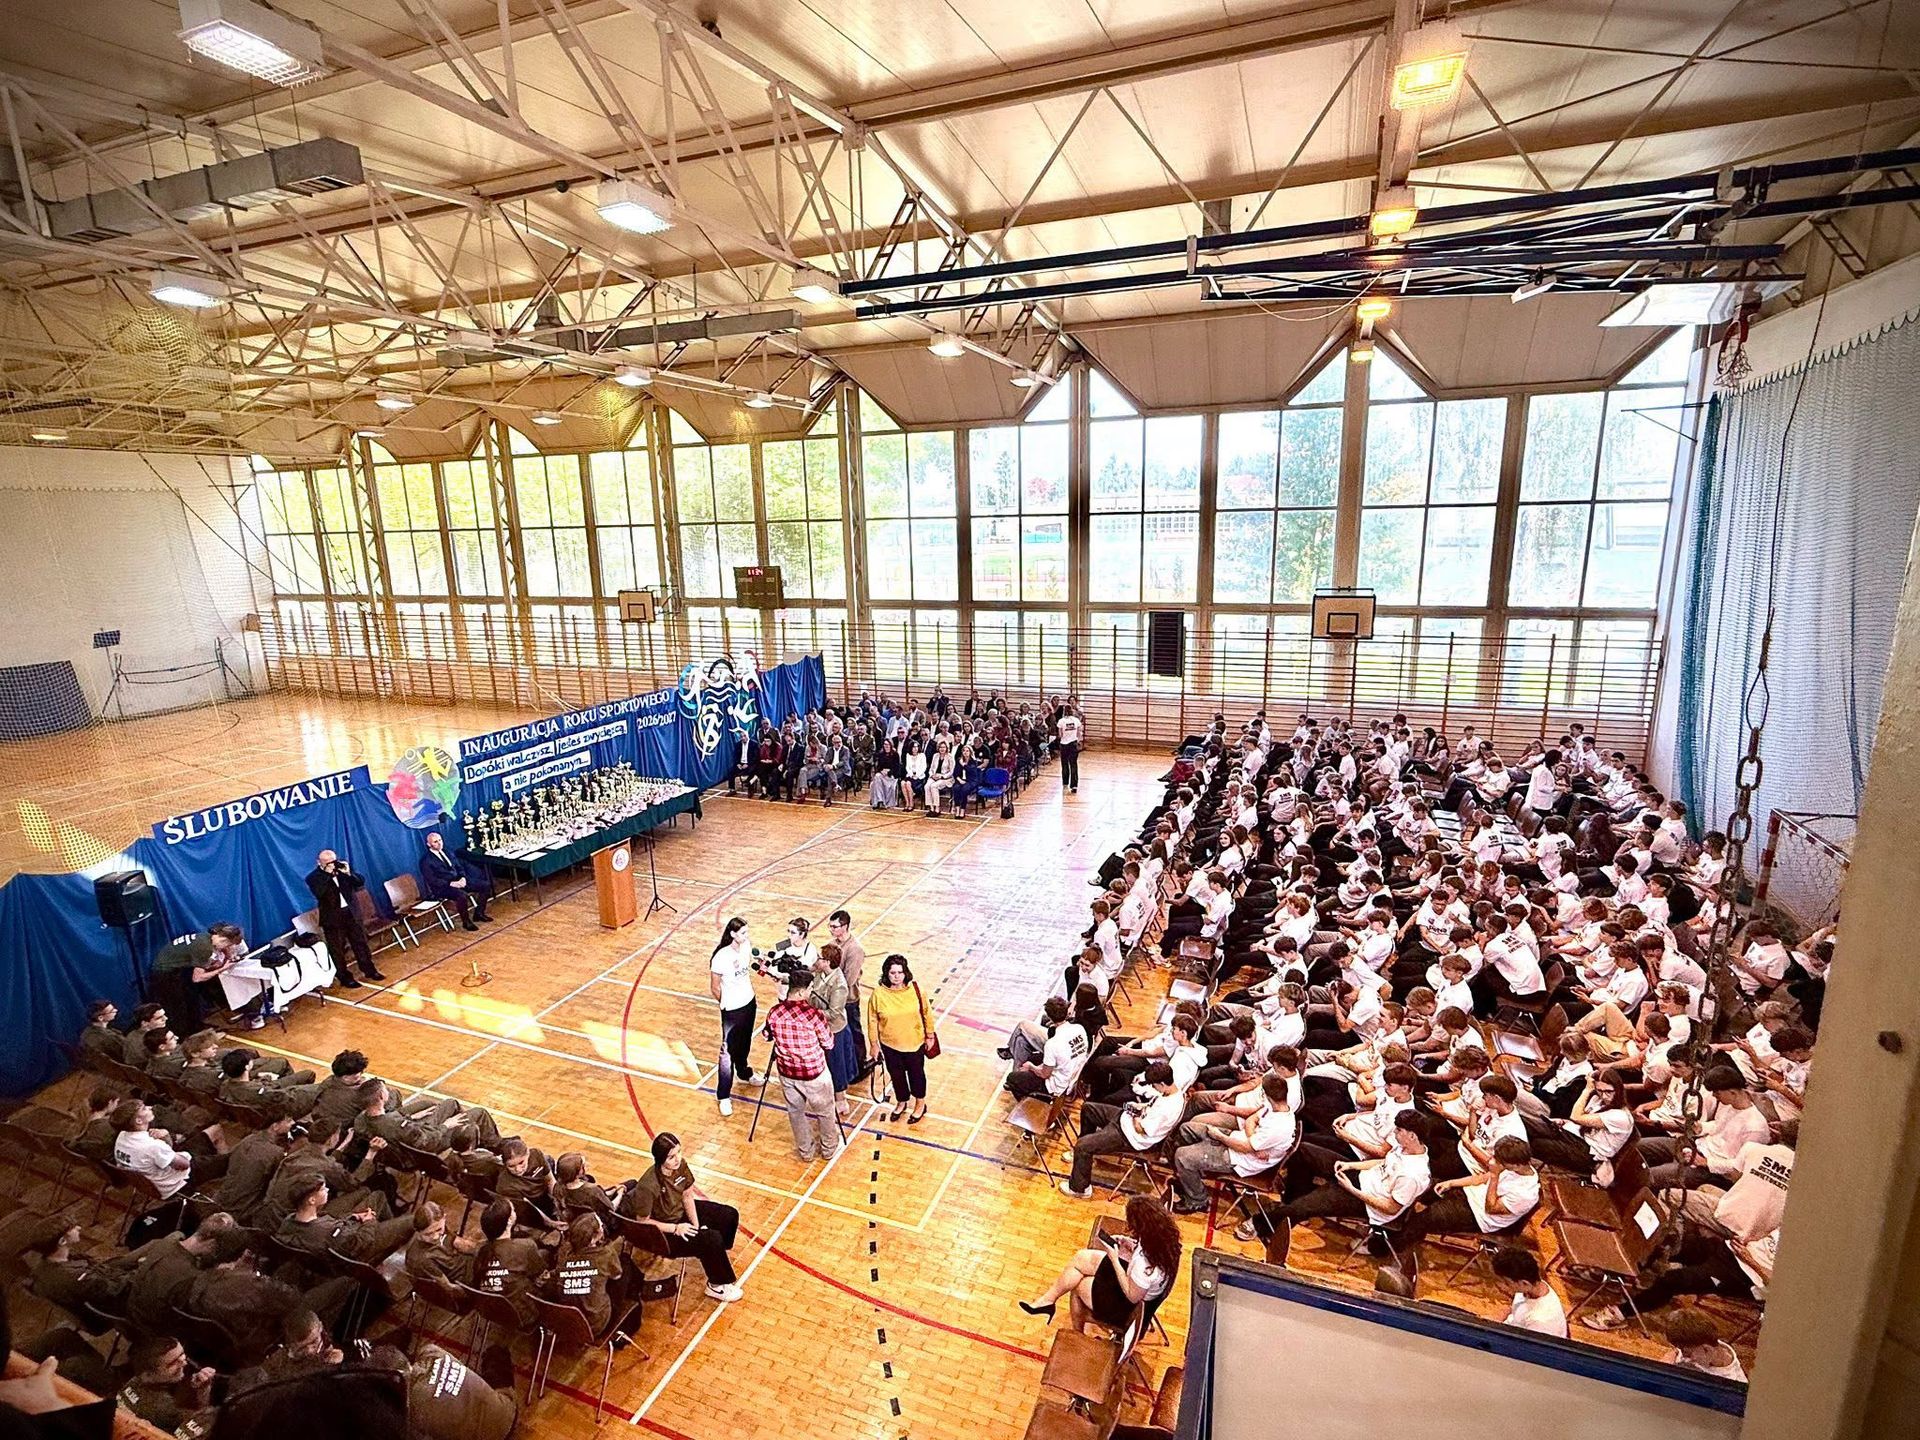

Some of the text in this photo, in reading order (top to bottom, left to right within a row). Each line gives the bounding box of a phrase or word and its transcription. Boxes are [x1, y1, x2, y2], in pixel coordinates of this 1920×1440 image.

[463, 690, 670, 757] INAUGURACJA ROKU SPORTOWEGO
[467, 758, 505, 780] Dopóki
[505, 781, 512, 789] a
[514, 773, 528, 786] nie
[163, 772, 354, 845] ŚLUBOWANIE
[1068, 1034, 1084, 1049] SMS
[566, 1260, 591, 1269] KLASA
[563, 1277, 591, 1289] SMS
